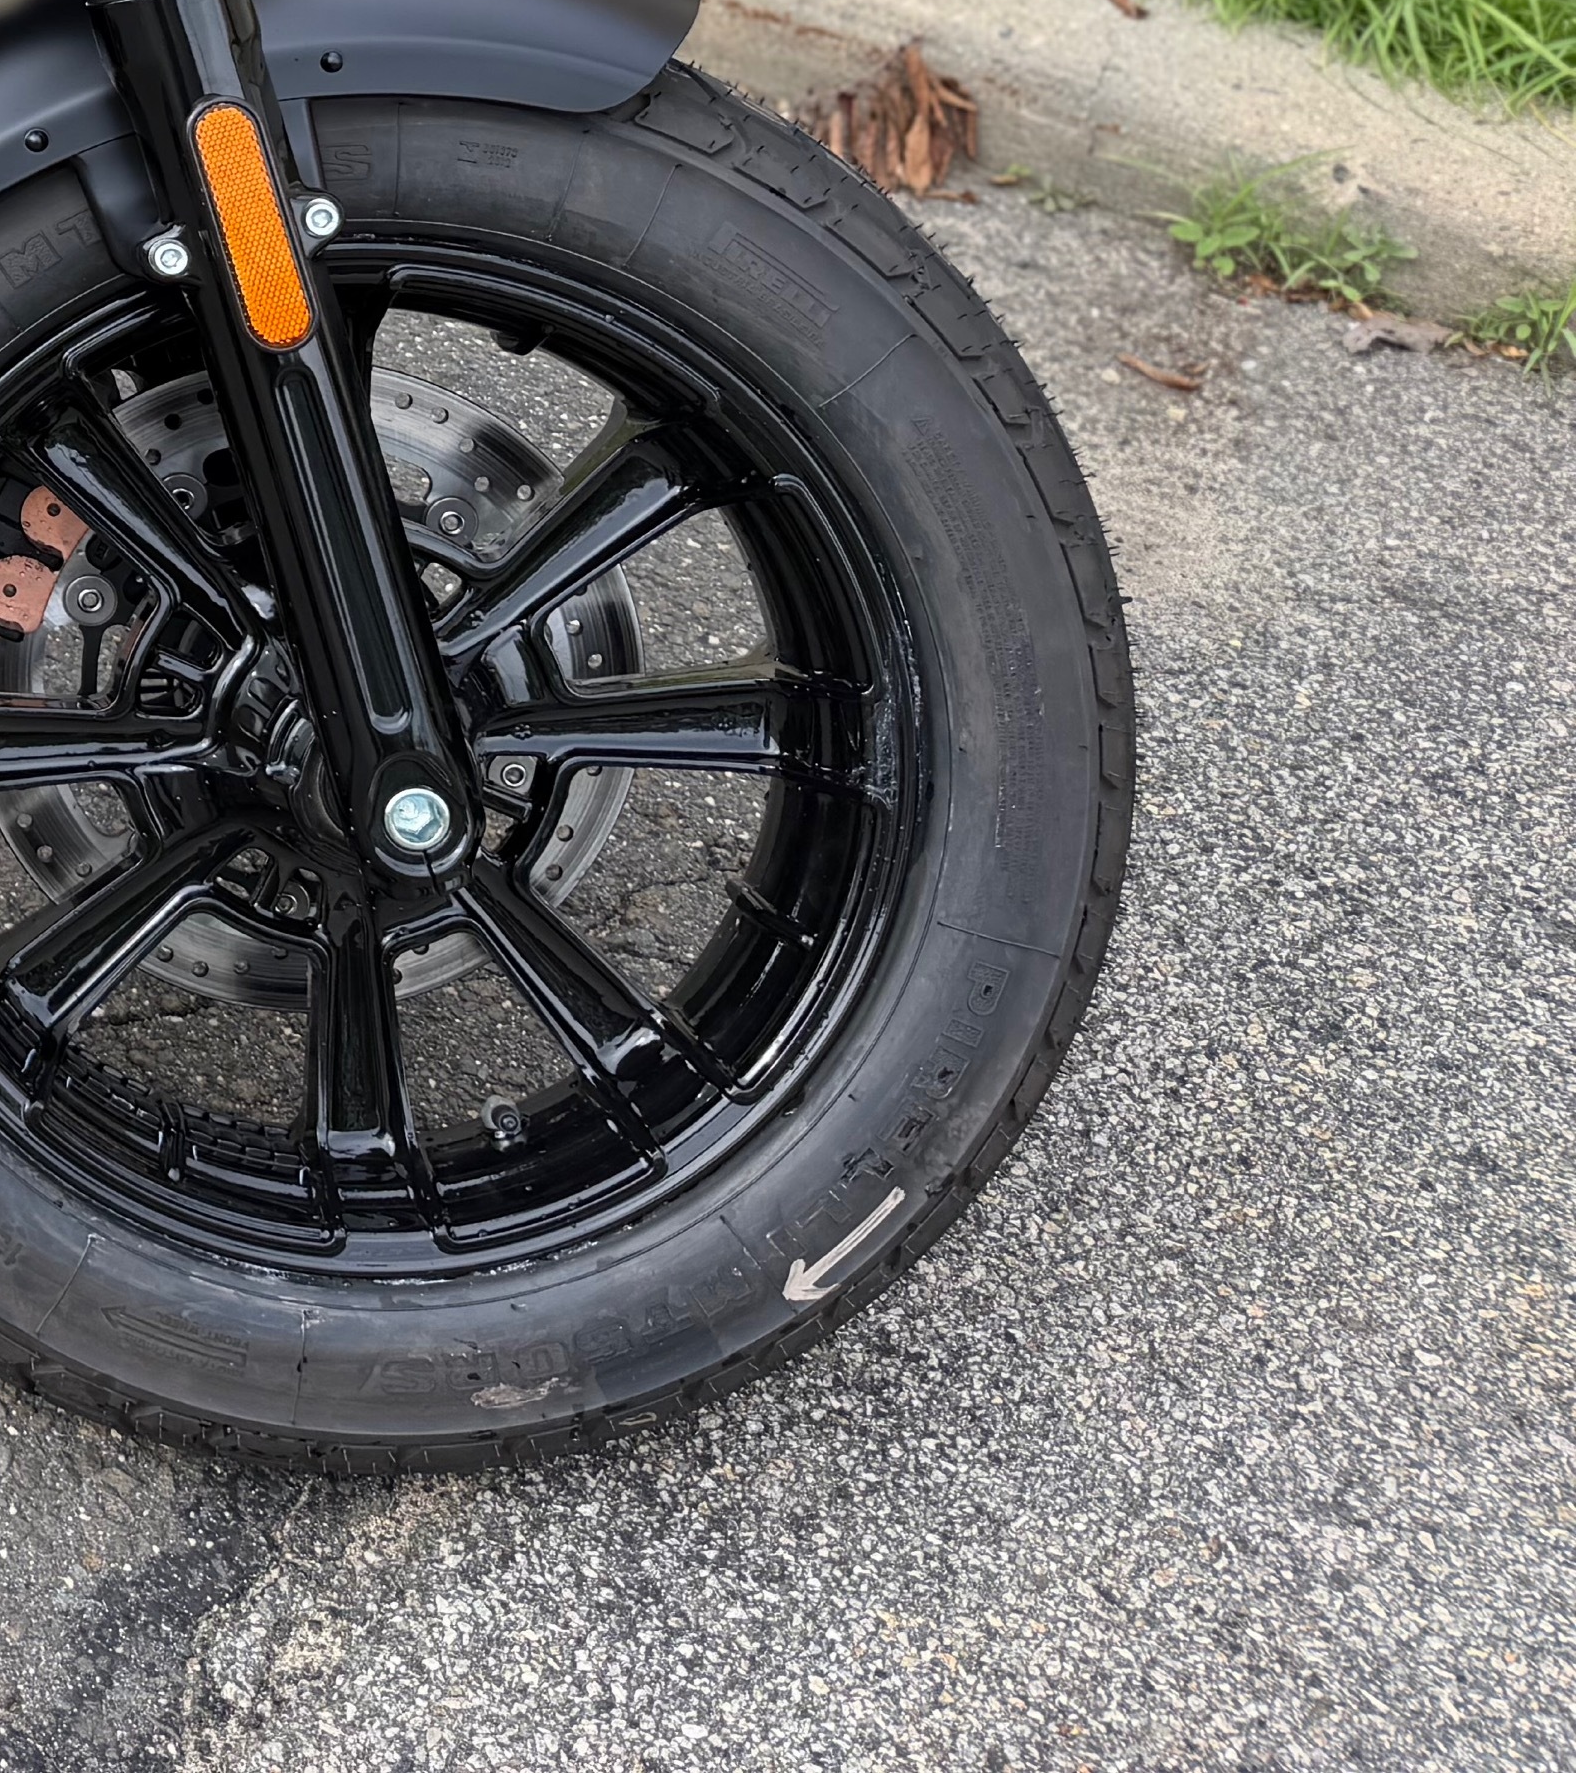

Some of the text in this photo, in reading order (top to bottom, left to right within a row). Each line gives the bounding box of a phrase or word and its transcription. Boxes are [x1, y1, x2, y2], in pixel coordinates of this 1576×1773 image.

[706, 220, 840, 330] PIRELLI
[764, 955, 1011, 1266] PIRELLI
[203, 1329, 250, 1349] FRONT
